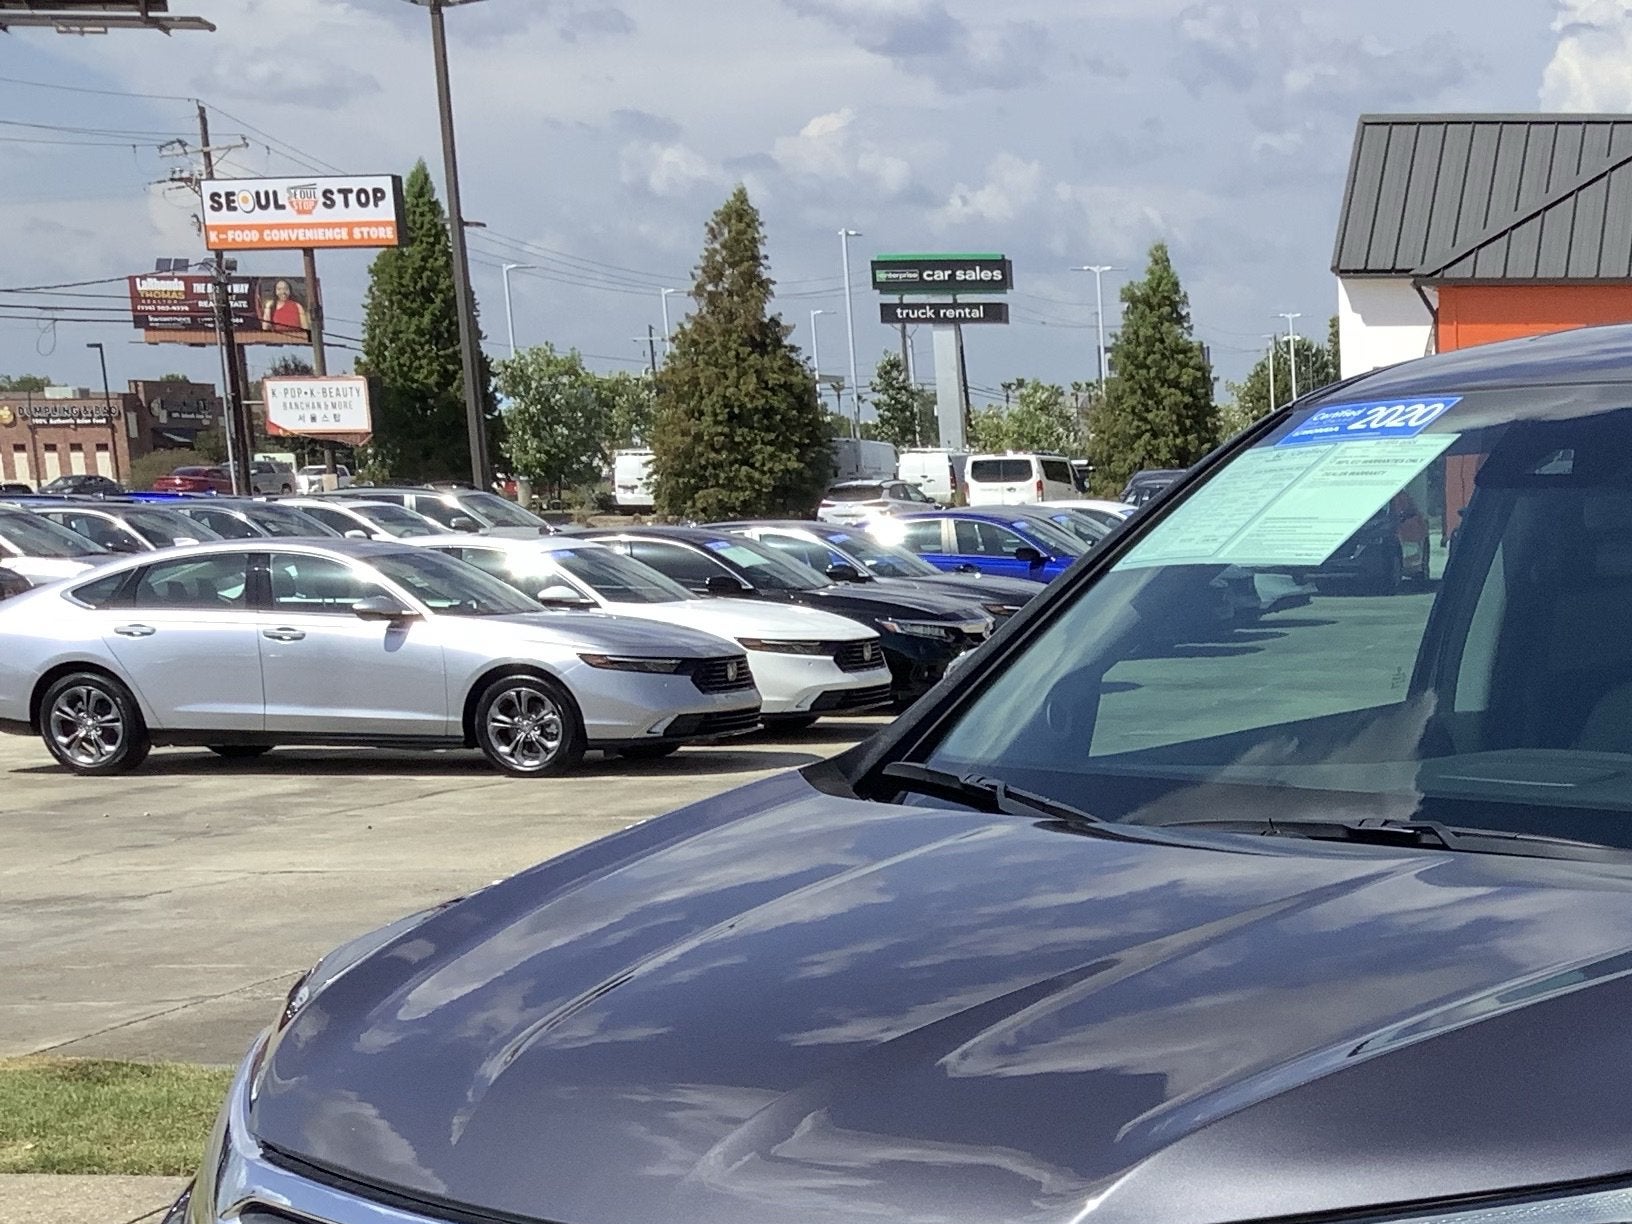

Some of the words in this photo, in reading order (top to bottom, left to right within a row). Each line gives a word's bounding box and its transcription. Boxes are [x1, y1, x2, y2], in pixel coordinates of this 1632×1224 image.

[322, 187, 387, 210] STOP
[209, 230, 260, 243] K-FOOD
[263, 228, 349, 242] CONVENIENCE
[352, 227, 394, 240] STORE
[922, 269, 952, 281] car
[955, 266, 1003, 281] sales
[140, 290, 185, 300] THOMAS
[896, 305, 936, 318] truck
[939, 305, 984, 318] rental
[1347, 402, 1445, 430] 2020
